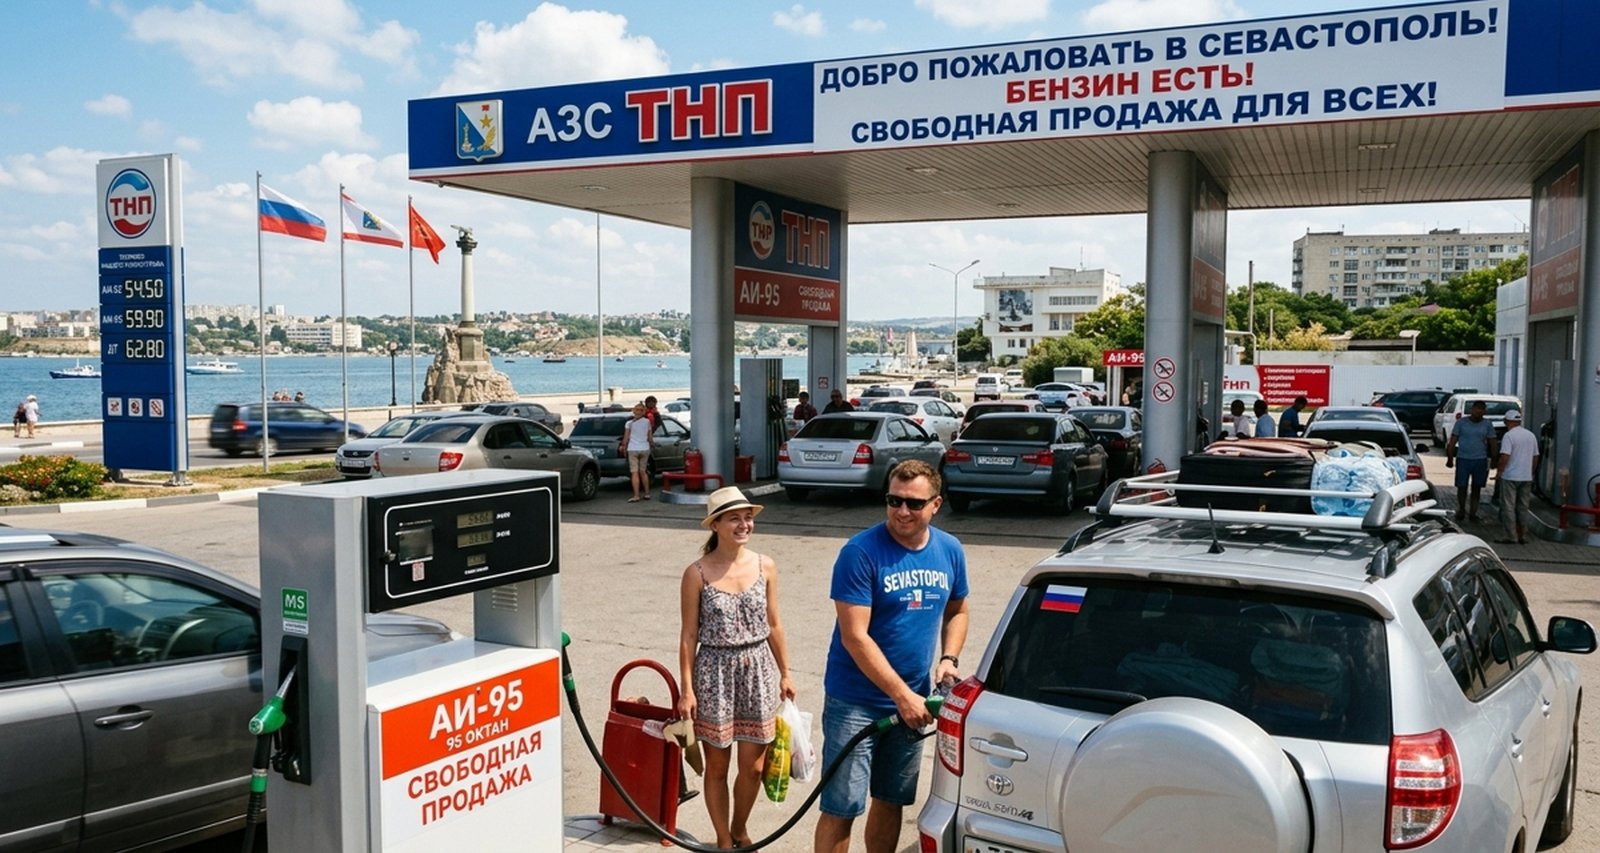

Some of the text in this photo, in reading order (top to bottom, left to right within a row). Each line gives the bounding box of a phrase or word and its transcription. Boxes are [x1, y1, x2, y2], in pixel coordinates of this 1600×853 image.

[820, 7, 1498, 93] ДОБРО ПОЖАЛОВАТЬ В СЕВАСТОПОЛЬ!
[1006, 62, 1254, 103] БЕНЗИН ЕСТЬ!
[527, 78, 773, 144] АЗС ТНП
[851, 82, 1437, 143] СВОБОДНАЯ ПРОДАЖА ДЛЯ ВСЕХ!
[109, 195, 152, 216] ТНП
[781, 209, 830, 270] ТНП
[125, 279, 163, 298] 54.50
[740, 281, 780, 306] АИ-95
[126, 310, 164, 328] 59.90
[126, 339, 165, 358] 62.80
[285, 594, 305, 609] MS
[429, 679, 523, 740] АИ-95
[446, 718, 509, 751] 95 ОКТАН
[408, 730, 542, 799] СВОБОДНАЯ
[422, 763, 532, 826] ПРОДАЖА
